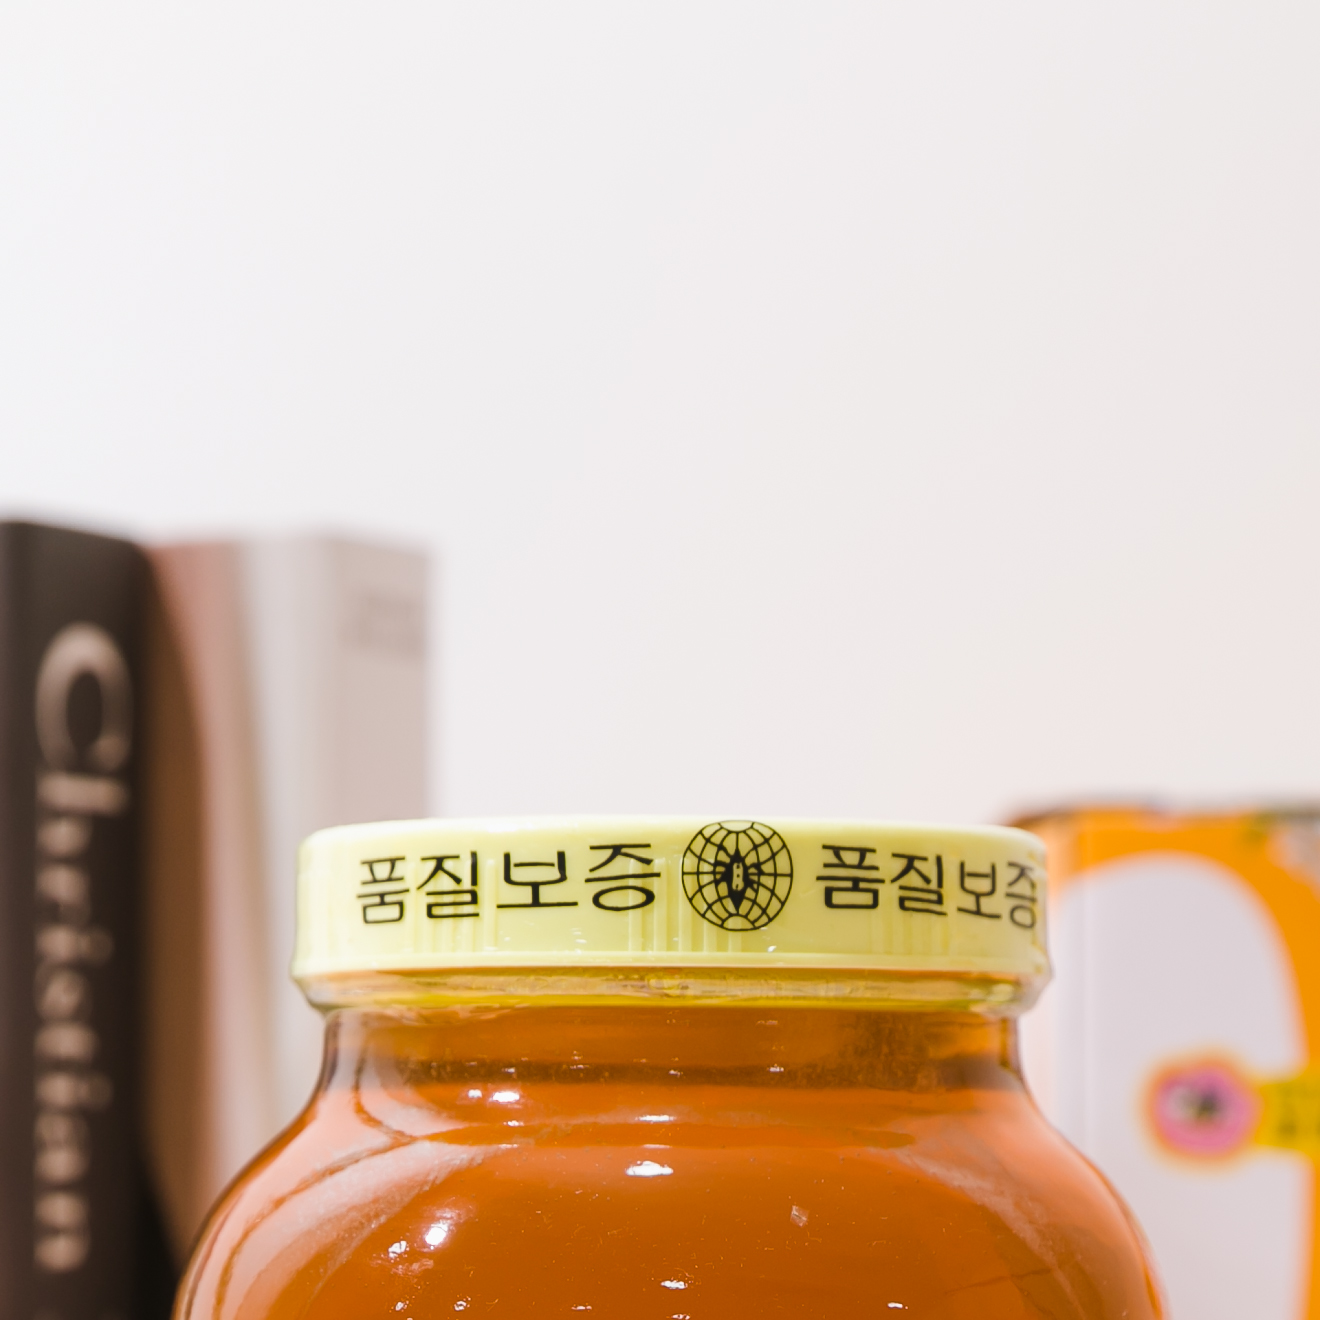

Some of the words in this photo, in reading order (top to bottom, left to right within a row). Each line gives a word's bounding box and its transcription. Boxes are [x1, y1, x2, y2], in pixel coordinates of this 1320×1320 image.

[357, 842, 662, 925] 품질보증
[816, 843, 1039, 931] 품질보증
[34, 621, 134, 1272] Christian
